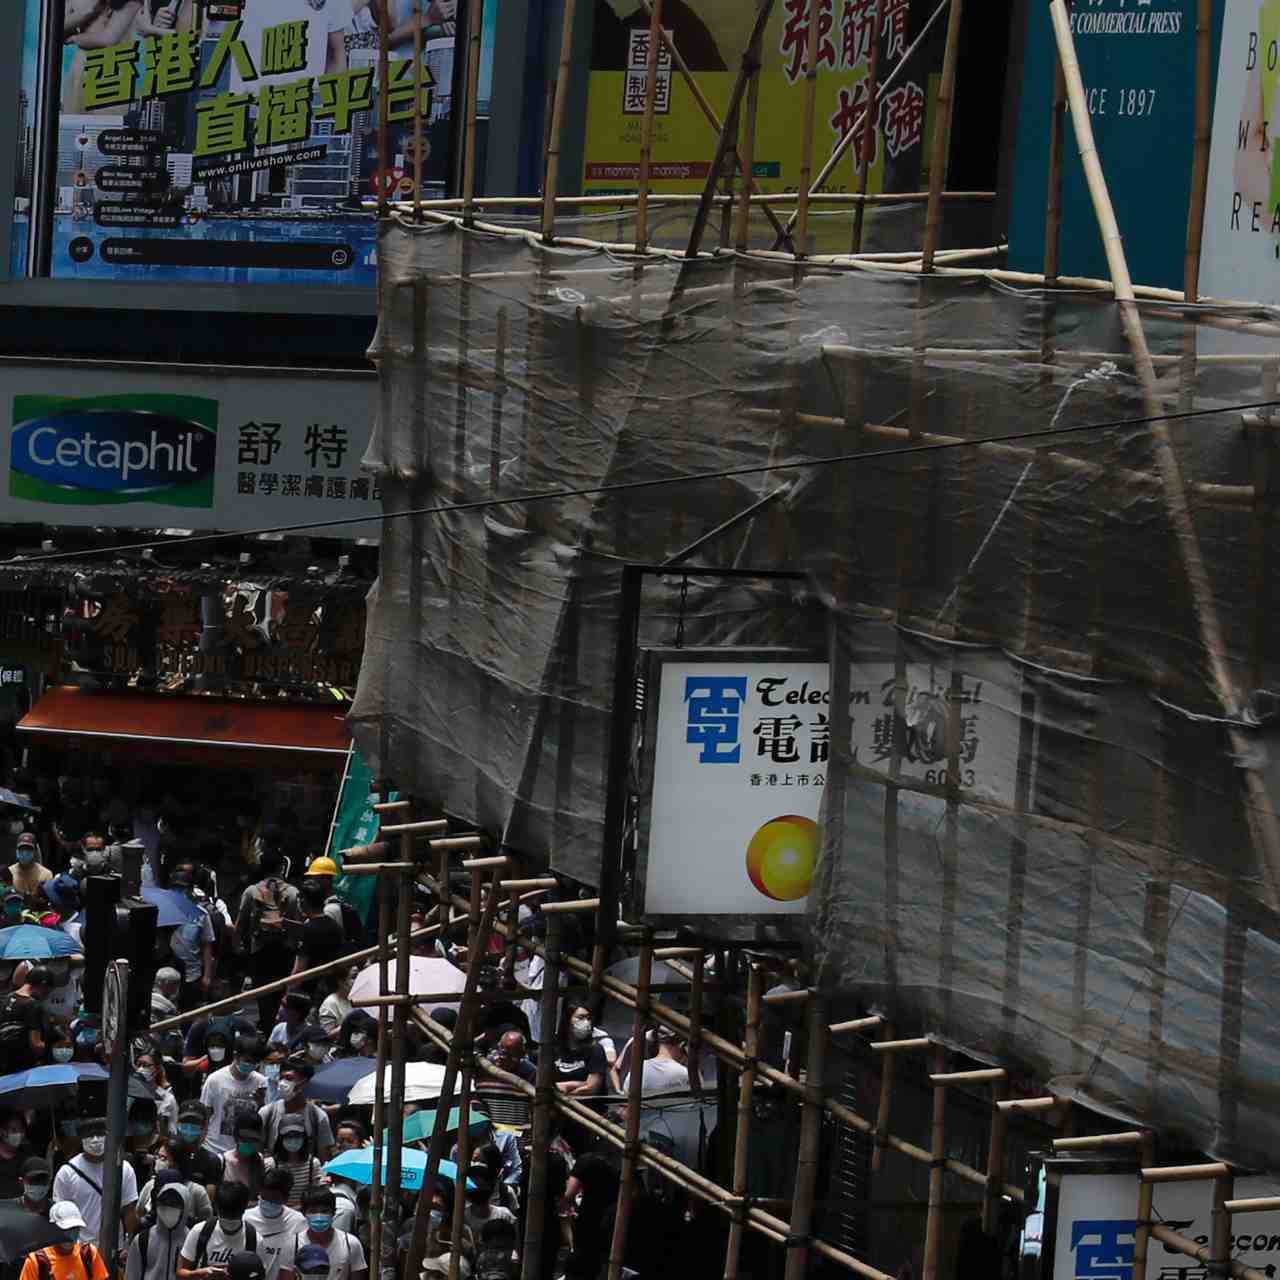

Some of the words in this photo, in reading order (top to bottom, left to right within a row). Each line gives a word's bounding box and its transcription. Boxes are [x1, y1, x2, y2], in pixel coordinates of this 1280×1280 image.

[1077, 13, 1148, 33] COMMERCIAL
[1150, 11, 1182, 33] PRESS
[193, 60, 430, 158] 直播平台
[1118, 89, 1156, 115] 1897
[197, 148, 321, 177] www.onliveshow.com
[28, 427, 199, 481] Cetaphil
[750, 773, 826, 787] 香港上市公
